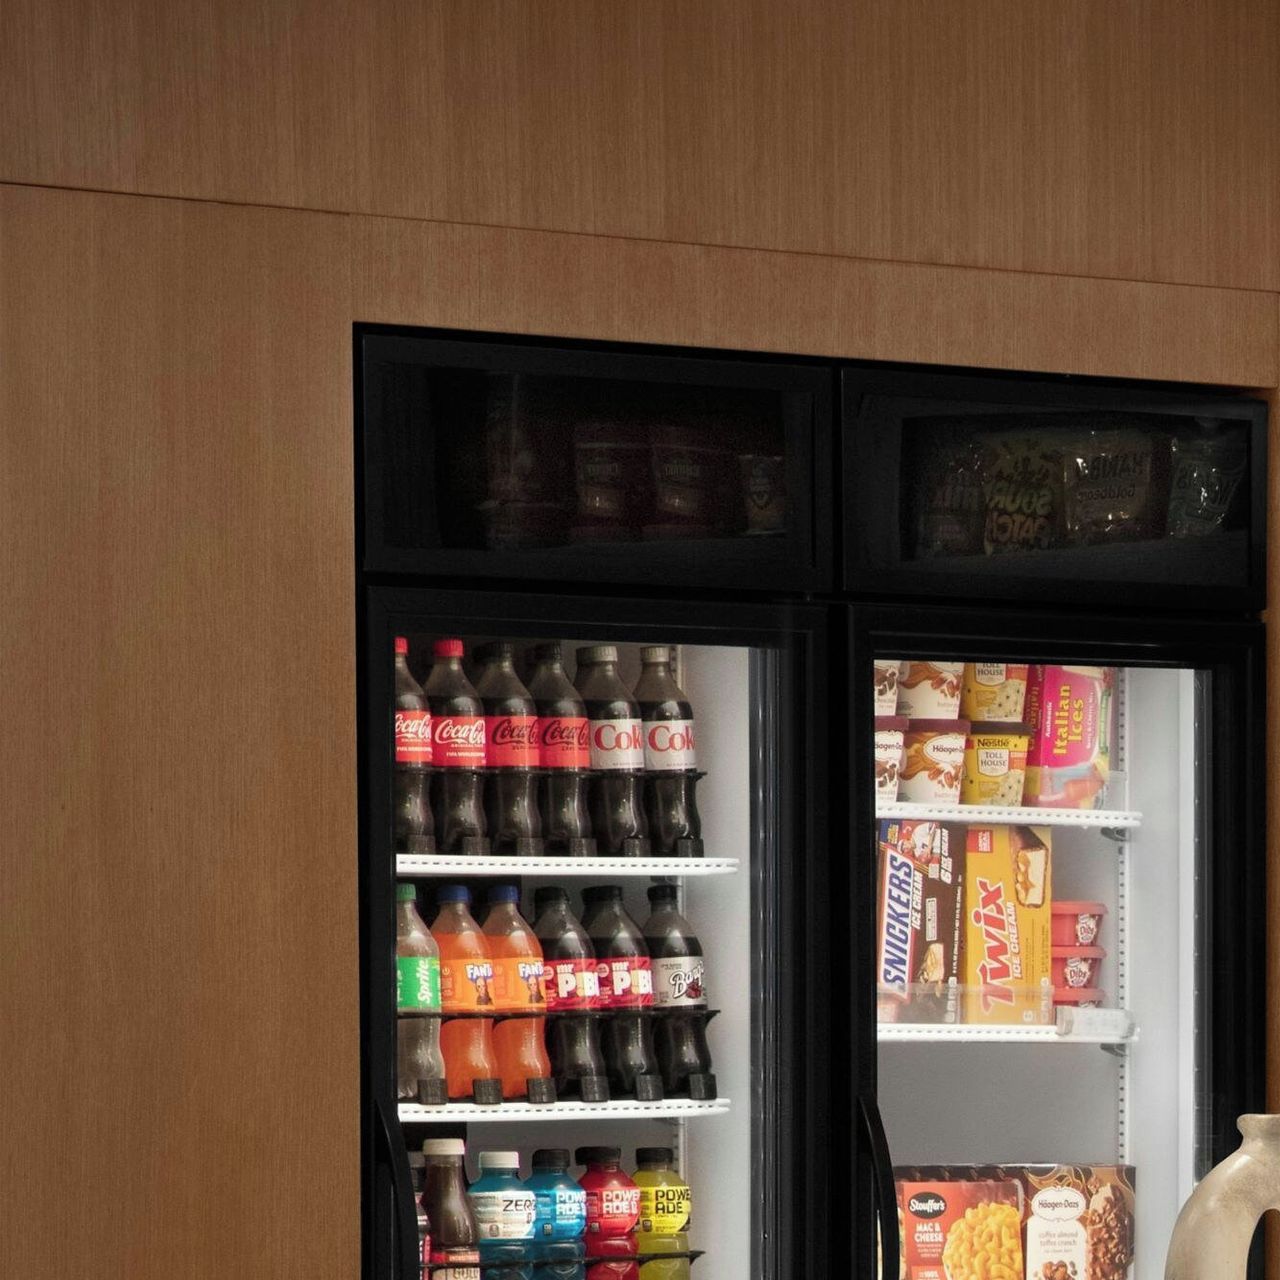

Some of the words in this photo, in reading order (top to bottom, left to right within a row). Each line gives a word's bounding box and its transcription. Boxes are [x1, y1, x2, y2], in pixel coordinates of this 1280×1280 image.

[1053, 685, 1071, 755] Italian
[1069, 698, 1084, 743] Ices
[595, 725, 643, 750] Cok
[649, 725, 695, 751] Cok
[981, 759, 1007, 768] HOUSE
[985, 751, 1003, 760] TOLL
[913, 872, 923, 911] CREAM
[883, 853, 913, 993] SNICKERS
[911, 911, 921, 929] ICE
[1007, 902, 1020, 957] CREAM
[1013, 957, 1022, 978] ICE
[417, 959, 432, 1003] Sprite
[655, 1189, 690, 1201] POWE
[655, 1201, 683, 1214] ADE
[909, 1199, 945, 1213] Stouffer's
[914, 1233, 943, 1242] CHEESE
[916, 1223, 933, 1232] MAC
